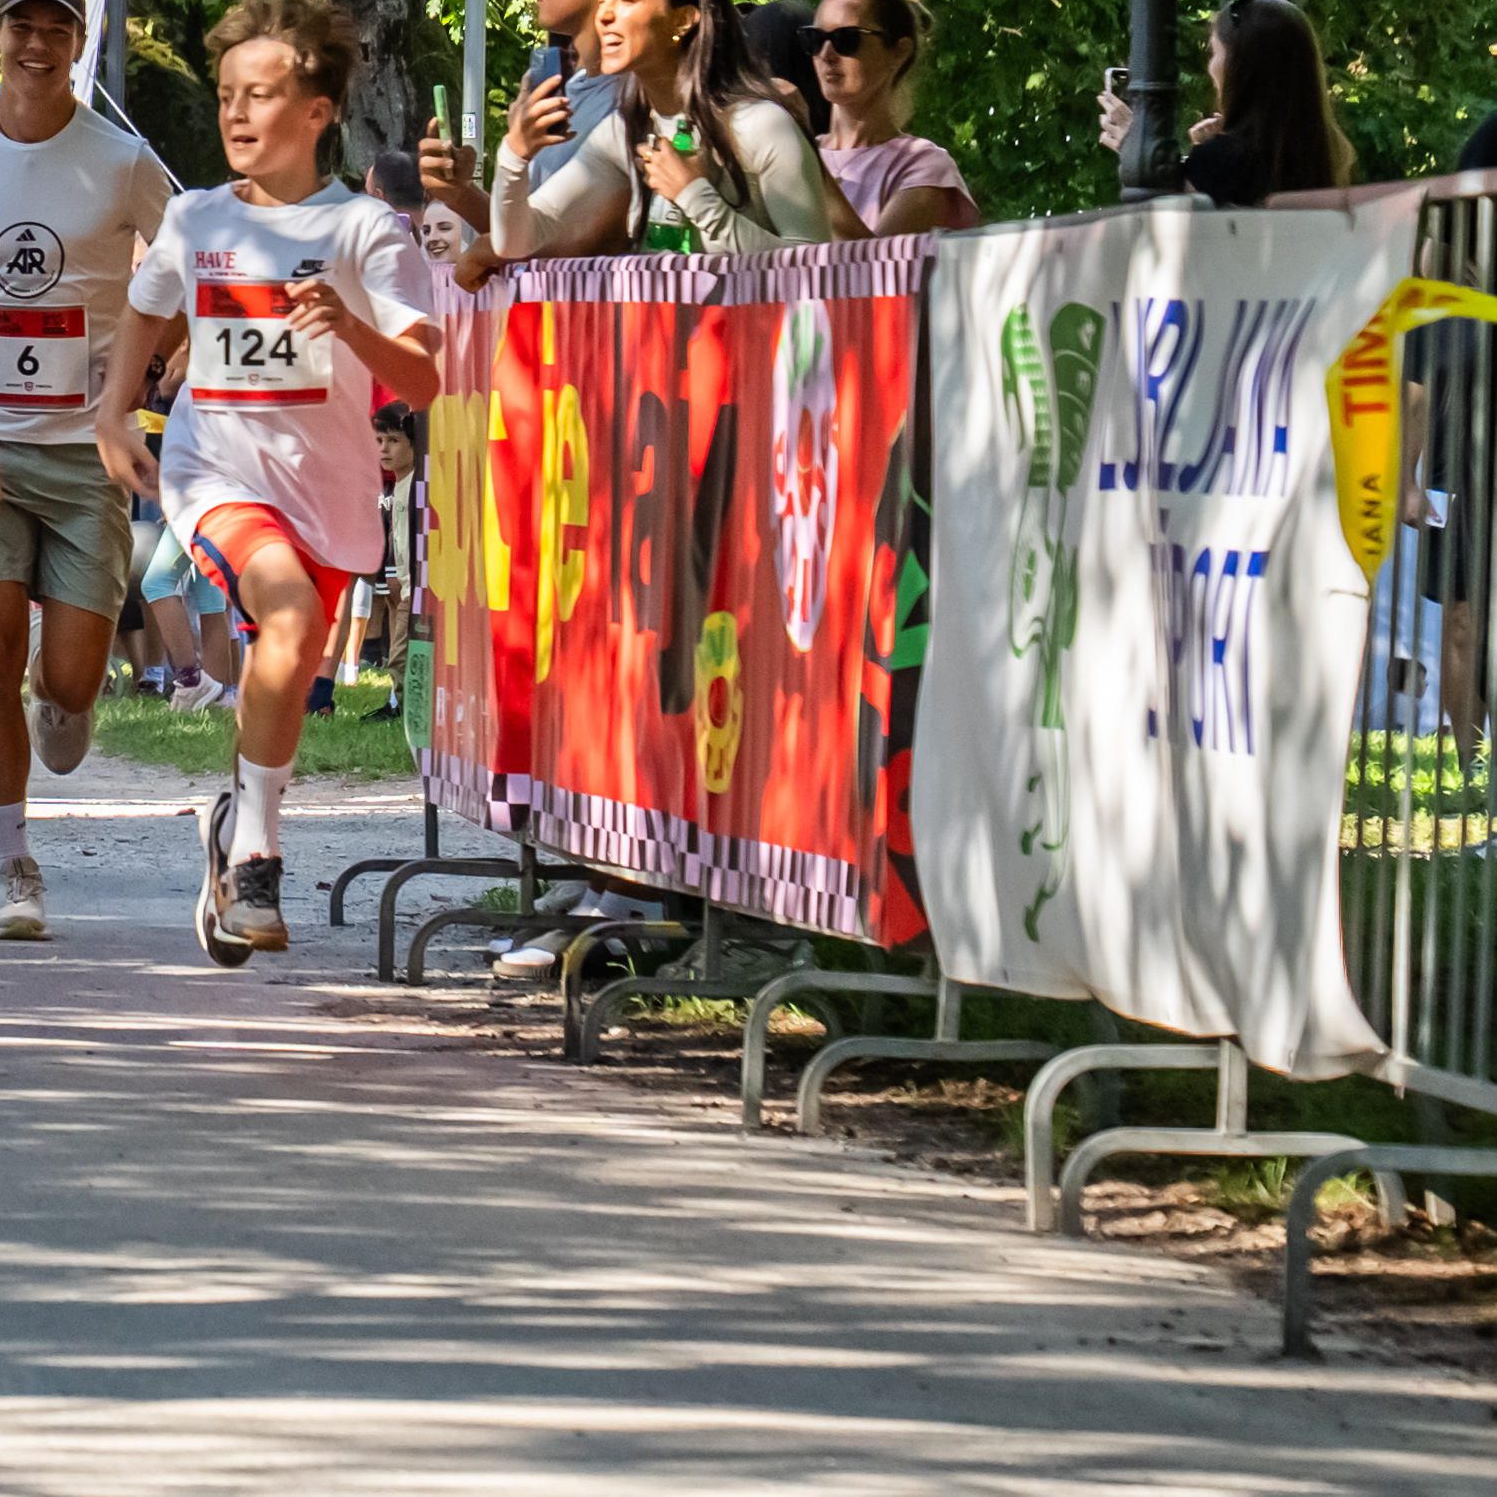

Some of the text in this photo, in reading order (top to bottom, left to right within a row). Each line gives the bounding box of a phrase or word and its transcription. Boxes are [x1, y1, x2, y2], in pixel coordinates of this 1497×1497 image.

[194, 250, 237, 269] HAVE
[16, 345, 40, 376] 6
[215, 327, 298, 367] 124
